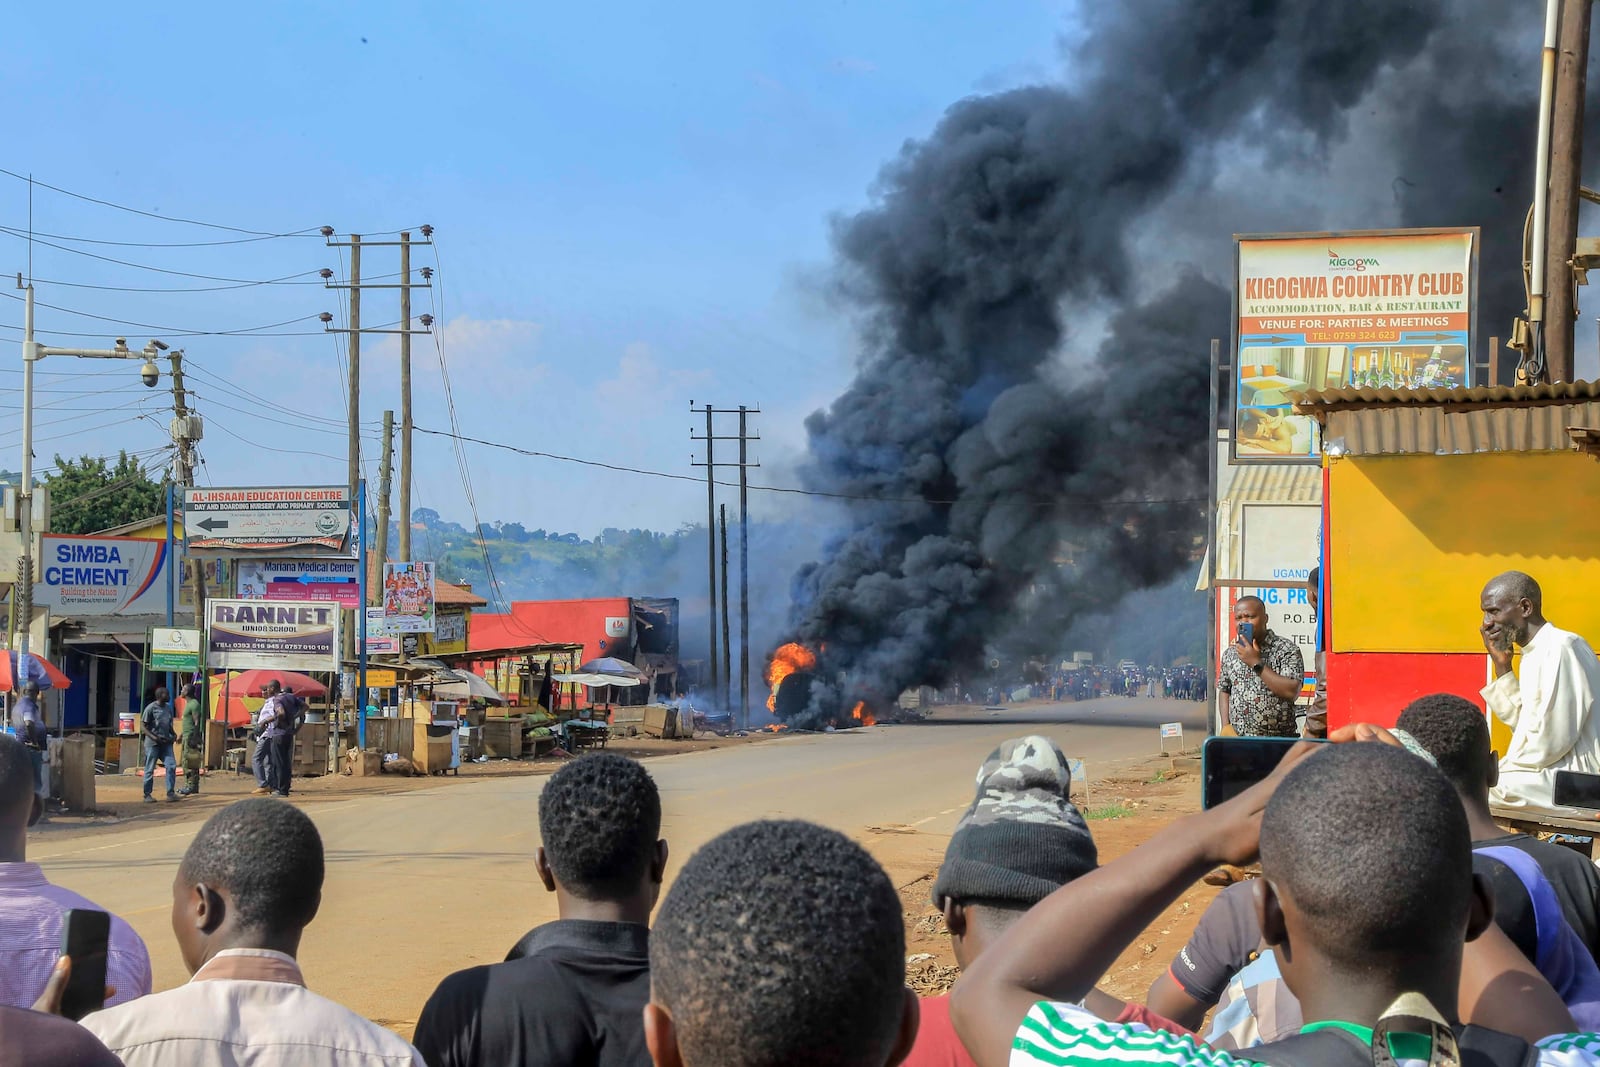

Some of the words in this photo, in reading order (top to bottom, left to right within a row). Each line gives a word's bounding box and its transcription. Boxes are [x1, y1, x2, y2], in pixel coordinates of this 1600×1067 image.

[1245, 276, 1328, 300] KIGOGWA
[1332, 274, 1414, 298] COUNTRY
[1418, 272, 1464, 296] CLUB
[1248, 304, 1346, 314] ACCOMMODATION,
[1349, 303, 1372, 312] BAR
[1375, 303, 1383, 312] &
[1386, 300, 1462, 312] RESTAURANT
[1259, 319, 1296, 330] VENUE
[1300, 318, 1325, 328] FOR:
[1328, 318, 1374, 328] PARTIES
[1376, 318, 1388, 328] &
[1390, 316, 1449, 327] MEETINGS
[1312, 332, 1332, 340] TEL:
[1334, 332, 1356, 340] 0759
[1359, 332, 1376, 340] 324
[1378, 330, 1396, 339] 623
[192, 492, 244, 502] AL-IHSAAN
[246, 491, 302, 500] EDUCATION
[304, 490, 342, 500] CENTRE
[56, 544, 122, 564] SIMBA
[264, 562, 296, 572] Mariana
[298, 562, 328, 572] Medical
[330, 562, 356, 573] Center
[1273, 569, 1309, 578] UGAND
[45, 566, 128, 586] CEMENT
[60, 587, 86, 597] Building
[86, 587, 98, 596] the
[98, 588, 118, 596] Nation
[1256, 588, 1282, 604] UG.
[1287, 588, 1308, 604] PR
[216, 606, 331, 624] RANNET
[1284, 614, 1304, 624] P.O.
[1309, 614, 1316, 624] B
